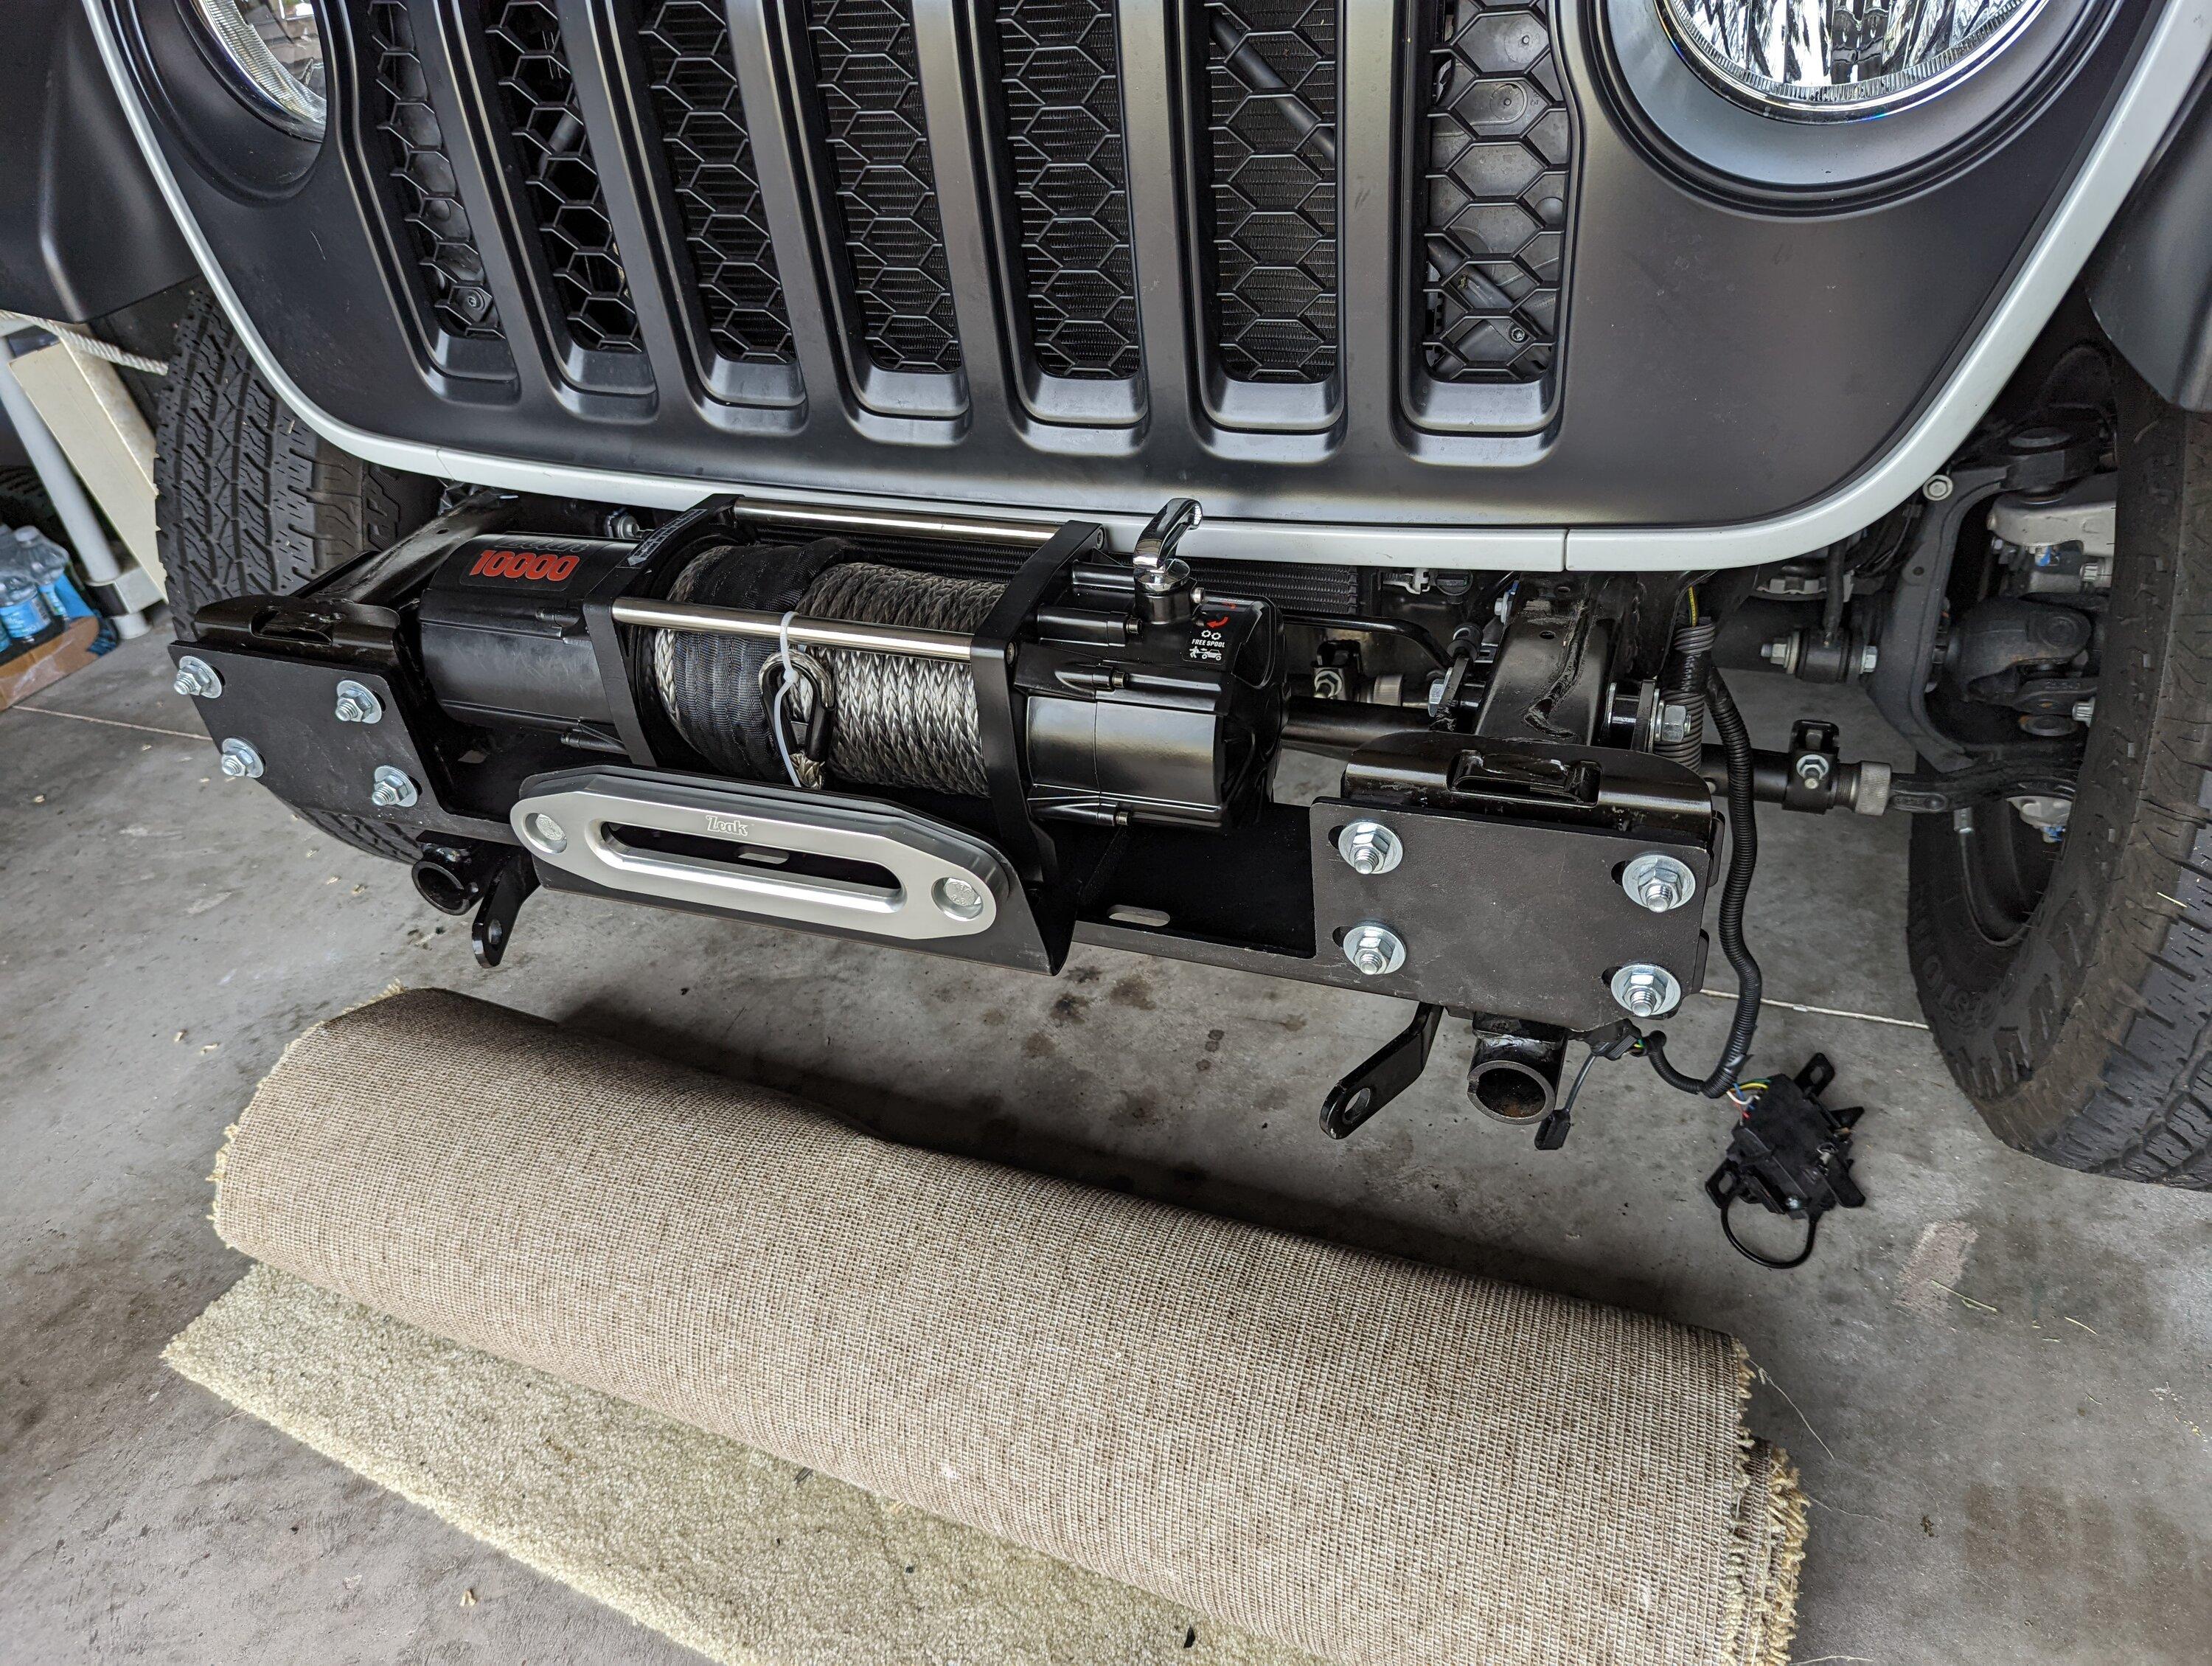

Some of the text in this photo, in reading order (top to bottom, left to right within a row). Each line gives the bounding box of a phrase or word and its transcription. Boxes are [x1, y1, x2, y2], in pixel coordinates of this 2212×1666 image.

[469, 549, 580, 581] 10000
[1192, 638, 1225, 648] FREE SPOOL
[706, 814, 748, 836] Zeak
